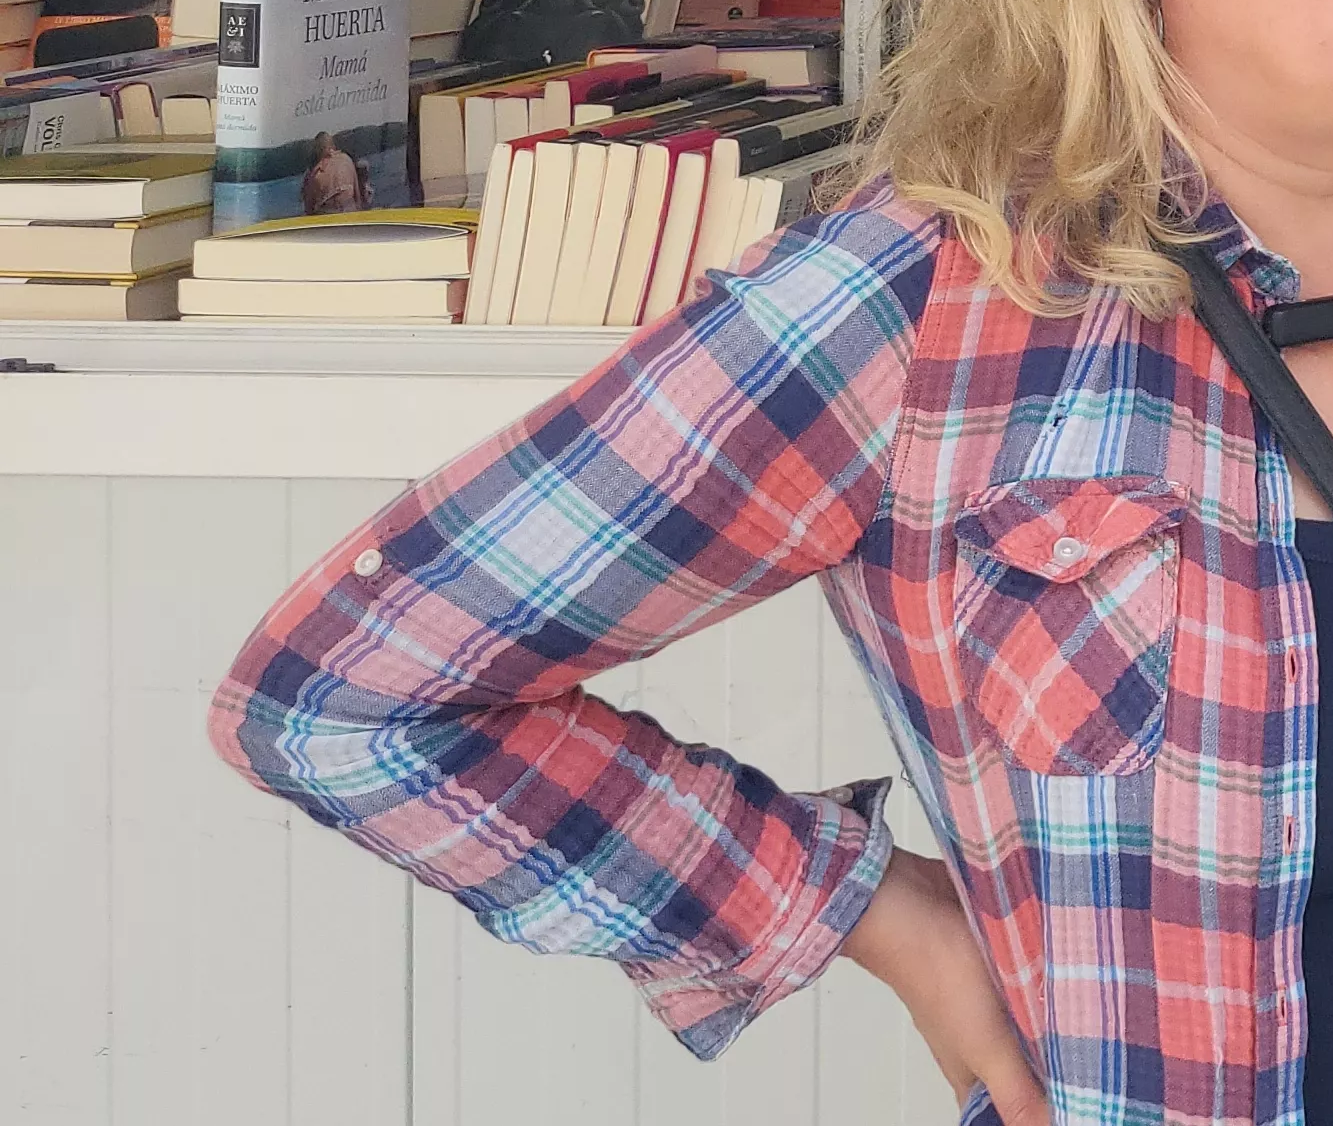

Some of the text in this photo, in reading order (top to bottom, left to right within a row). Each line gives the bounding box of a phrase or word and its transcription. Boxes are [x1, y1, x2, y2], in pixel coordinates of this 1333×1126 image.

[304, 6, 385, 44] HUERTA
[319, 49, 368, 80] Mamá
[294, 78, 388, 118] está dormida
